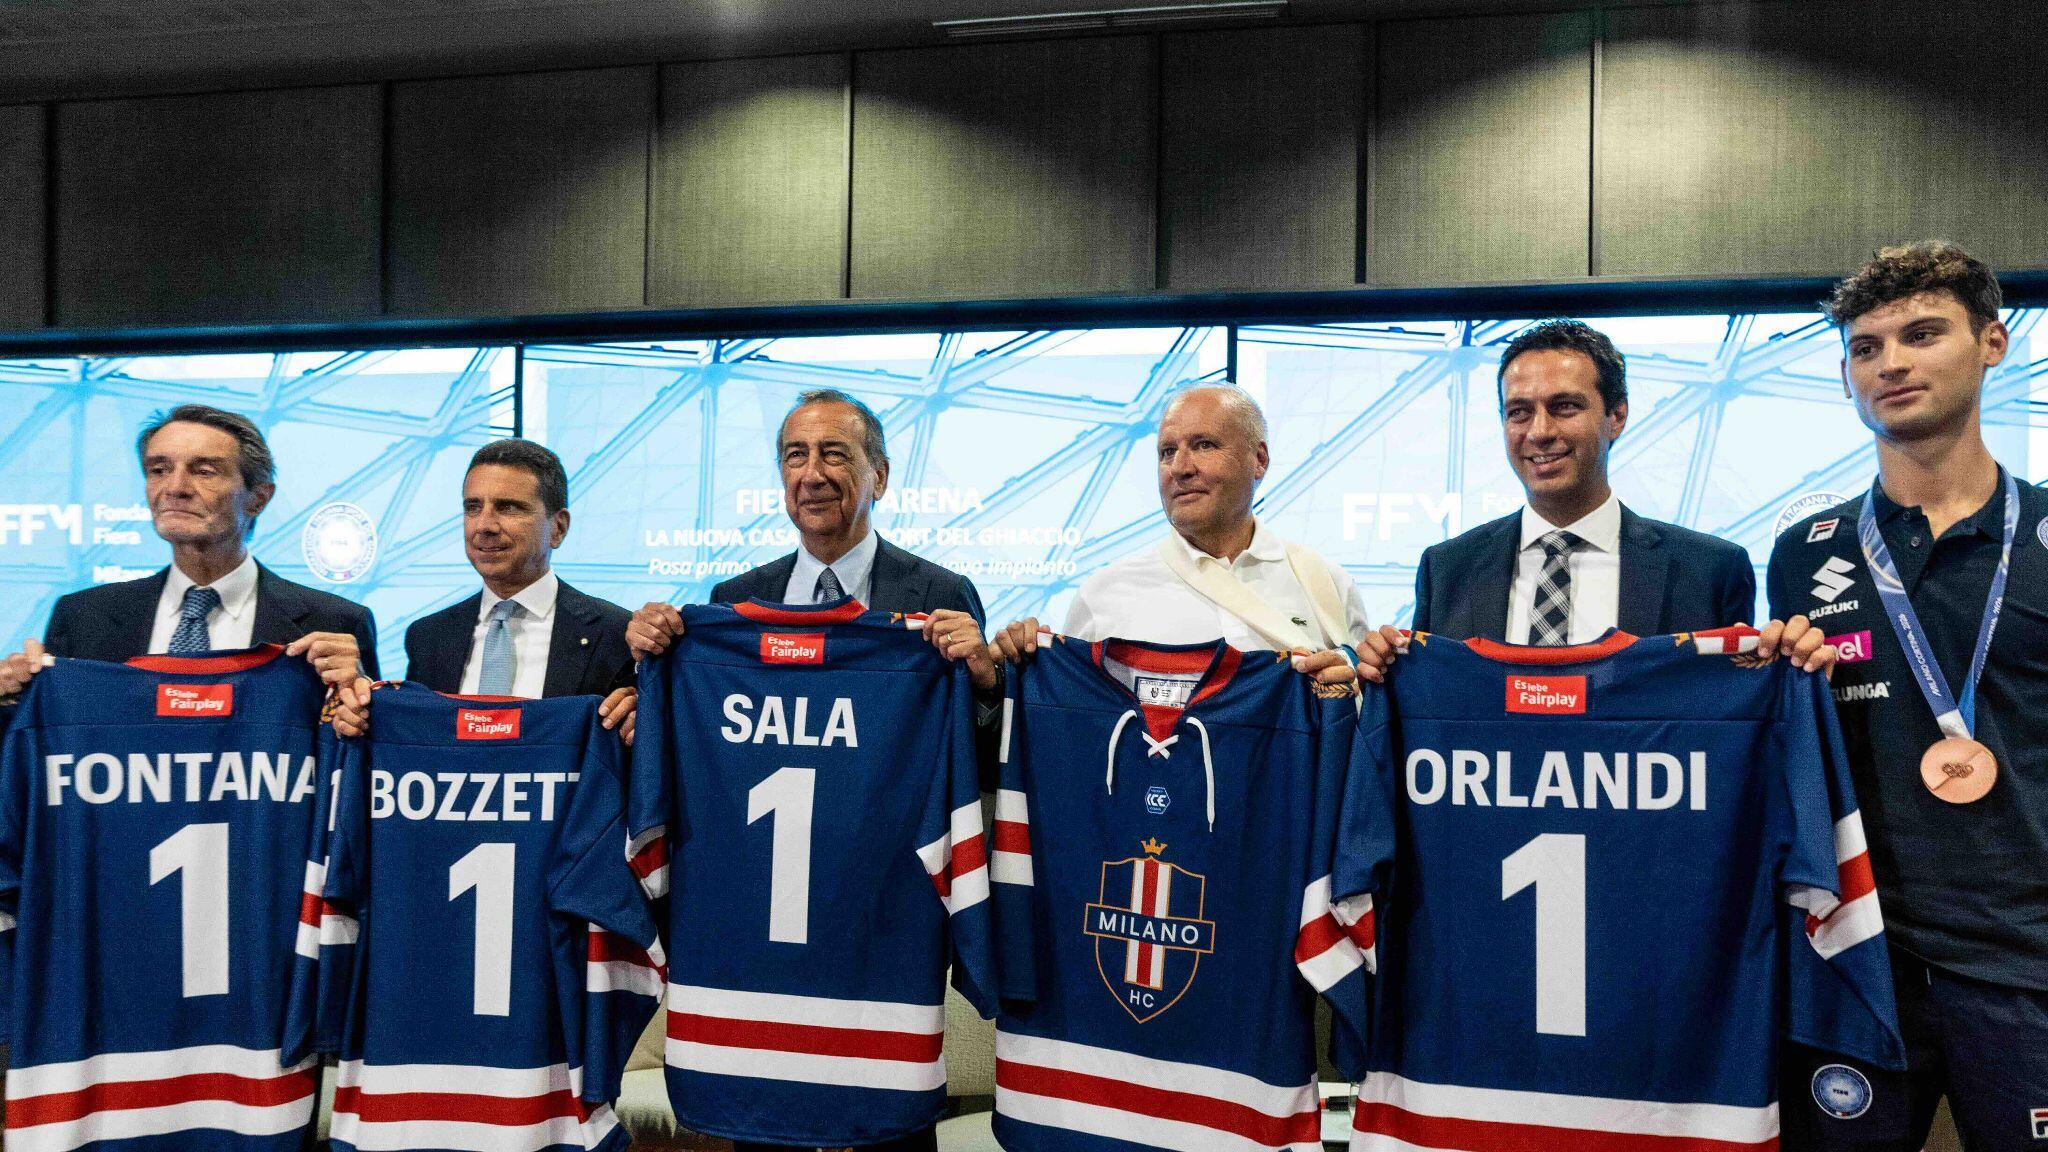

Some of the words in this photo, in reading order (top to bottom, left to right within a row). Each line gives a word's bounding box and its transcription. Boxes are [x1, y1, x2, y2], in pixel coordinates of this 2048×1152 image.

[878, 487, 983, 514] ARENA
[645, 529, 669, 547] LA
[673, 529, 744, 547] NUOVA
[749, 529, 800, 547] CASA
[878, 527, 931, 547] PORT
[936, 528, 975, 546] DEL
[981, 527, 1081, 547] GHIACCIO
[648, 558, 692, 576] Posa
[694, 557, 751, 580] primo
[987, 555, 1077, 580] impianto
[1808, 600, 1859, 621] SUZUKI
[767, 636, 778, 645] Es
[771, 645, 817, 659] Fairplay
[1514, 679, 1527, 690] Es
[1527, 683, 1549, 692] lebe
[169, 698, 225, 712] Fairplay
[1519, 691, 1578, 708] Fairplay
[464, 712, 475, 721] Es
[721, 693, 859, 748] SALA
[468, 722, 513, 735] Fairplay
[45, 751, 317, 806] FONTANA
[1405, 748, 1707, 811] ORLANDI
[1146, 793, 1167, 807] ICE
[746, 766, 817, 944] 1
[149, 822, 230, 998] 1
[448, 842, 516, 1017] 1
[1098, 911, 1200, 945] MILANO
[1501, 832, 1587, 1037] 1
[1129, 989, 1155, 1008] HC
